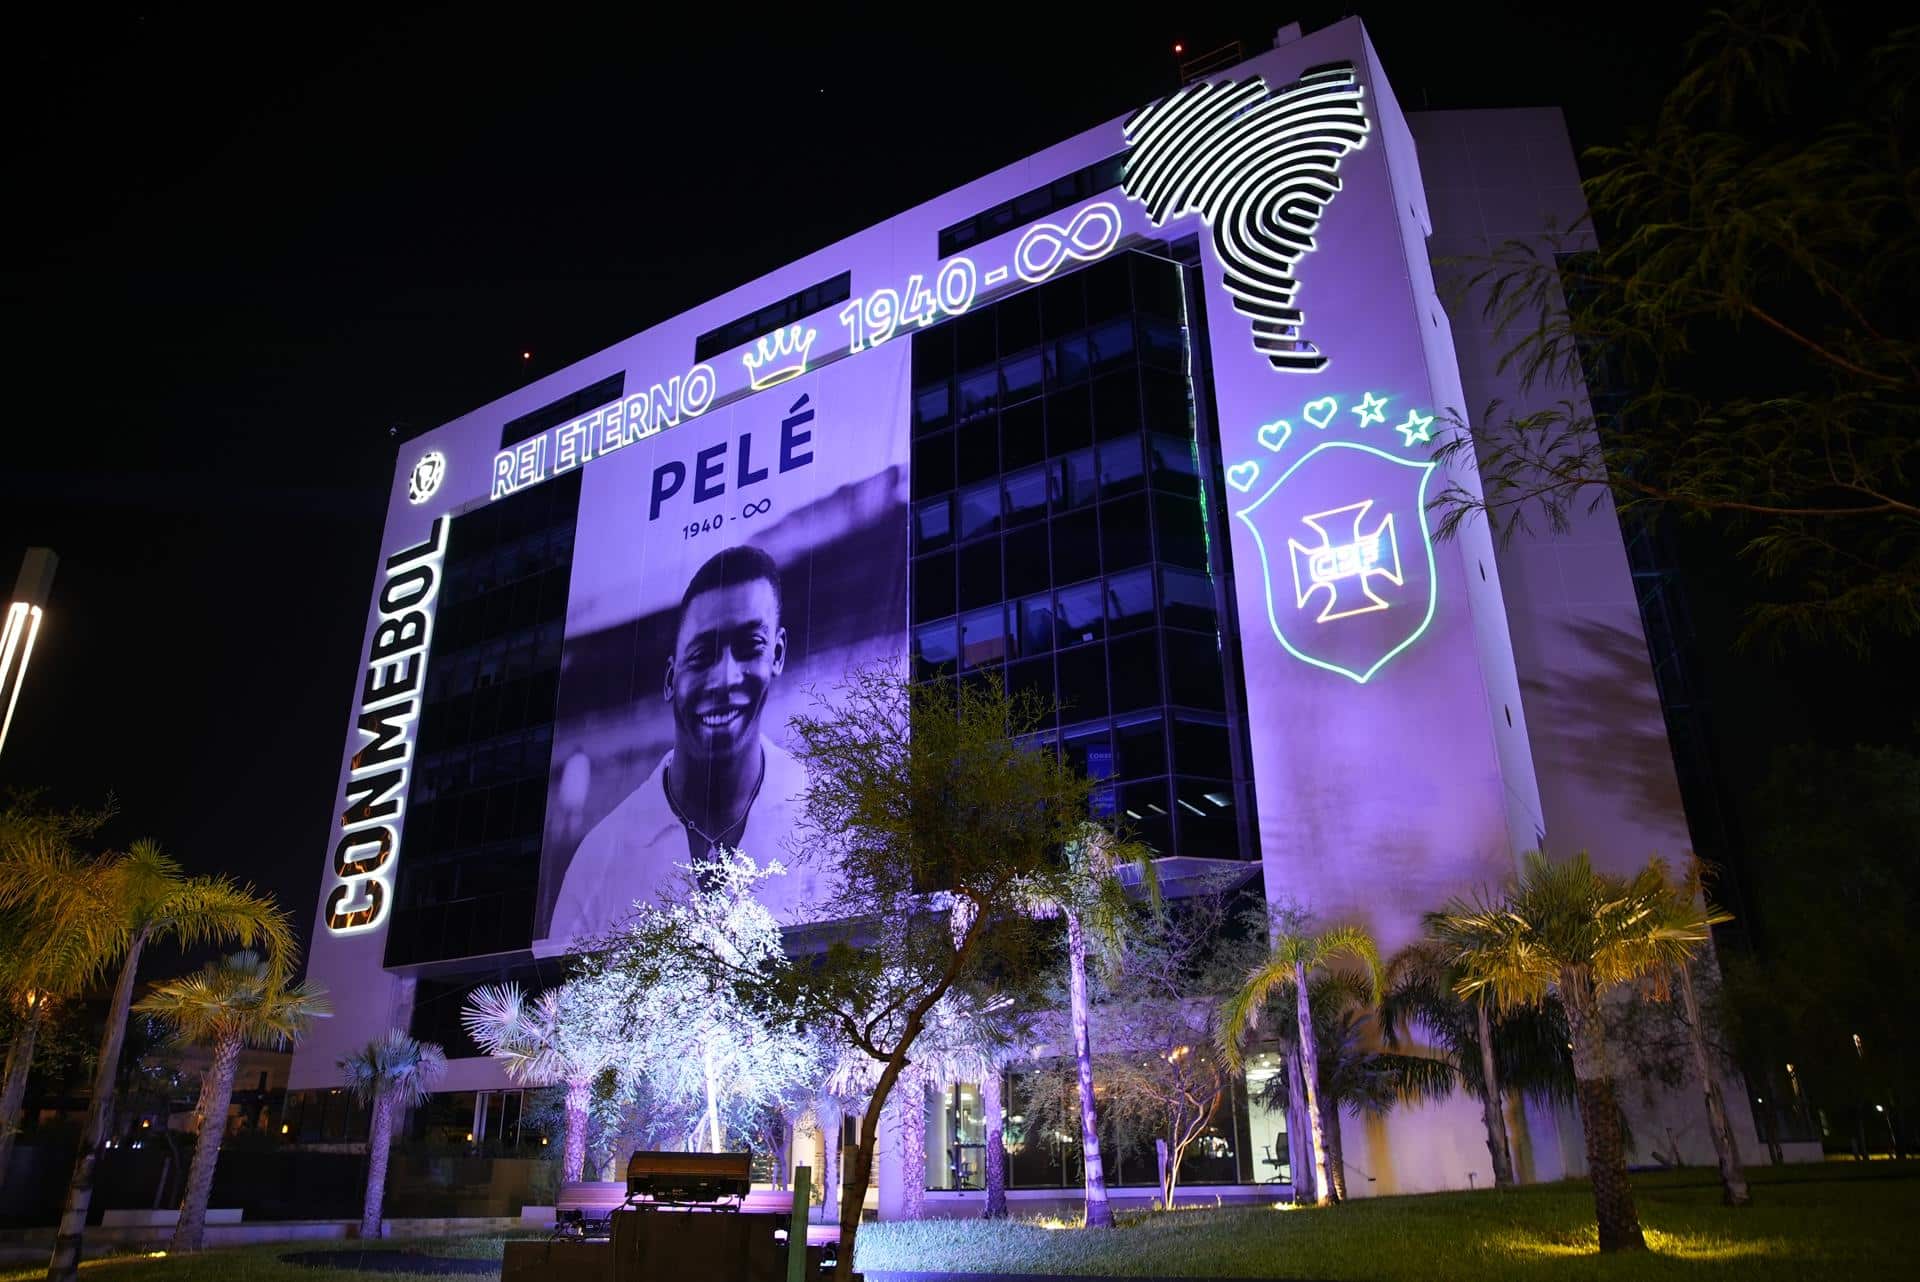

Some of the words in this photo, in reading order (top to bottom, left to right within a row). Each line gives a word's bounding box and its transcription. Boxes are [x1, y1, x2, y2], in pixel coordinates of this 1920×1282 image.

[491, 433, 547, 500] REI
[553, 363, 716, 475] ETERNO
[649, 393, 815, 521] PELÉ
[325, 514, 450, 934] CONMEBOL
